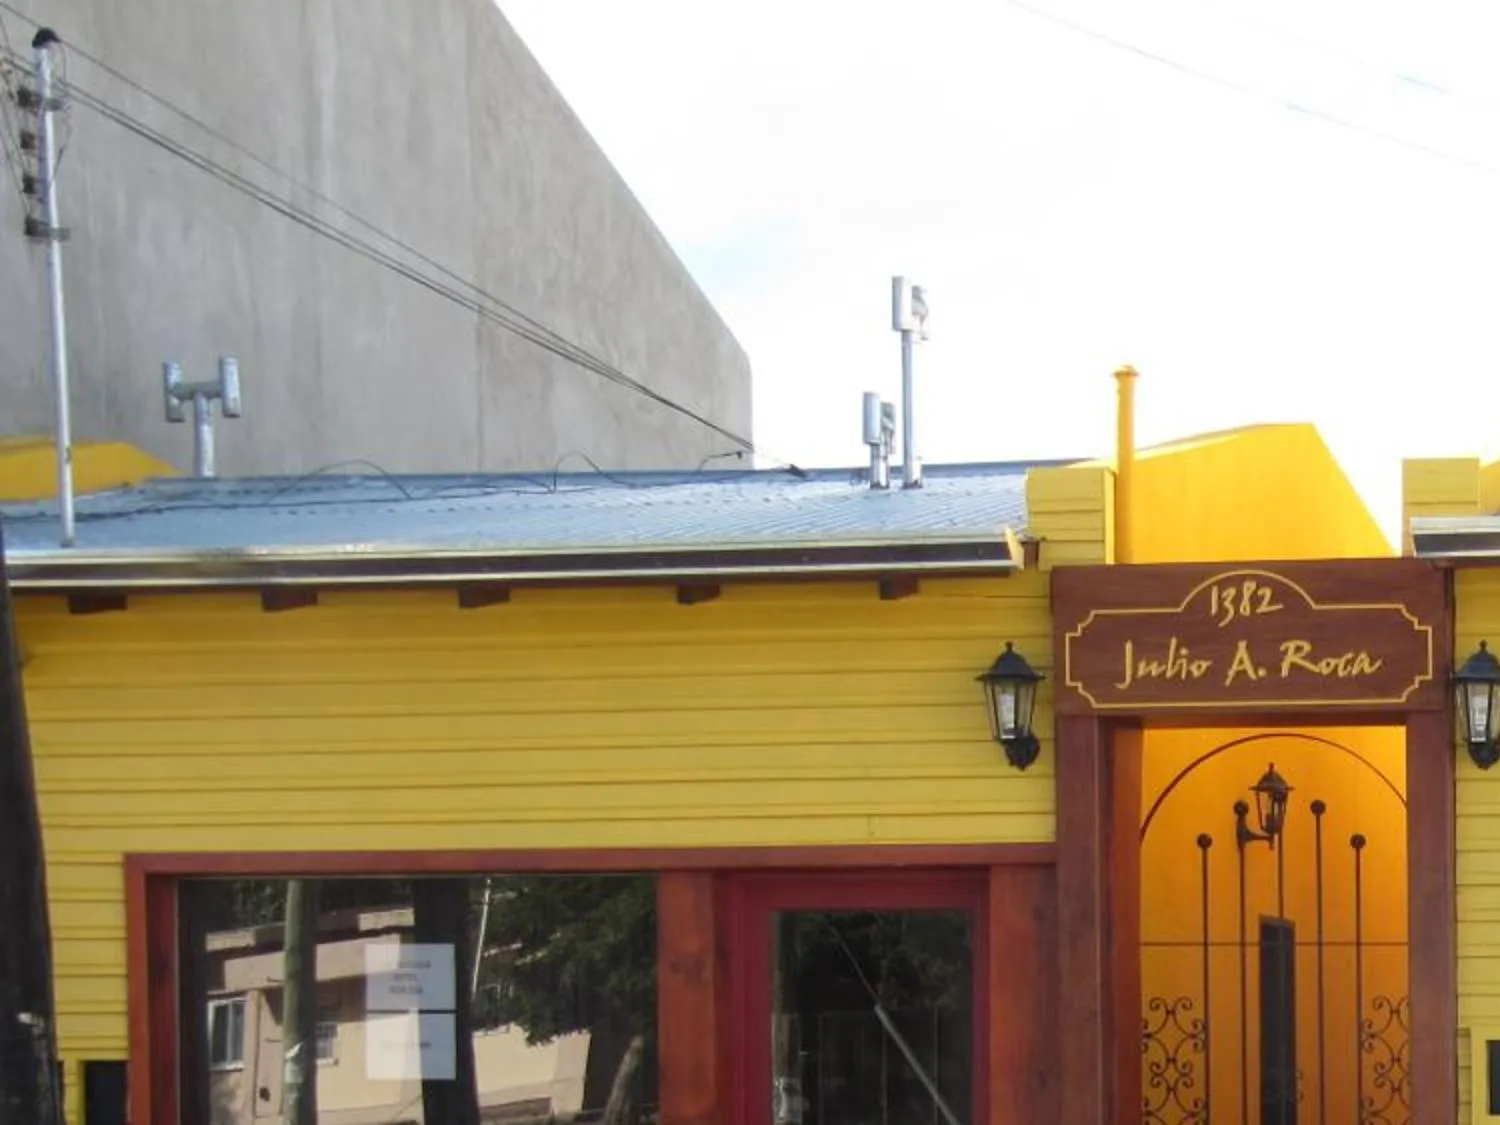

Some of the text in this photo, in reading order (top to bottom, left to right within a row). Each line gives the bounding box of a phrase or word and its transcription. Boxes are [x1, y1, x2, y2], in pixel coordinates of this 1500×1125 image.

[1210, 580, 1284, 627] 1382
[1115, 637, 1383, 689] Julio A. Roca
